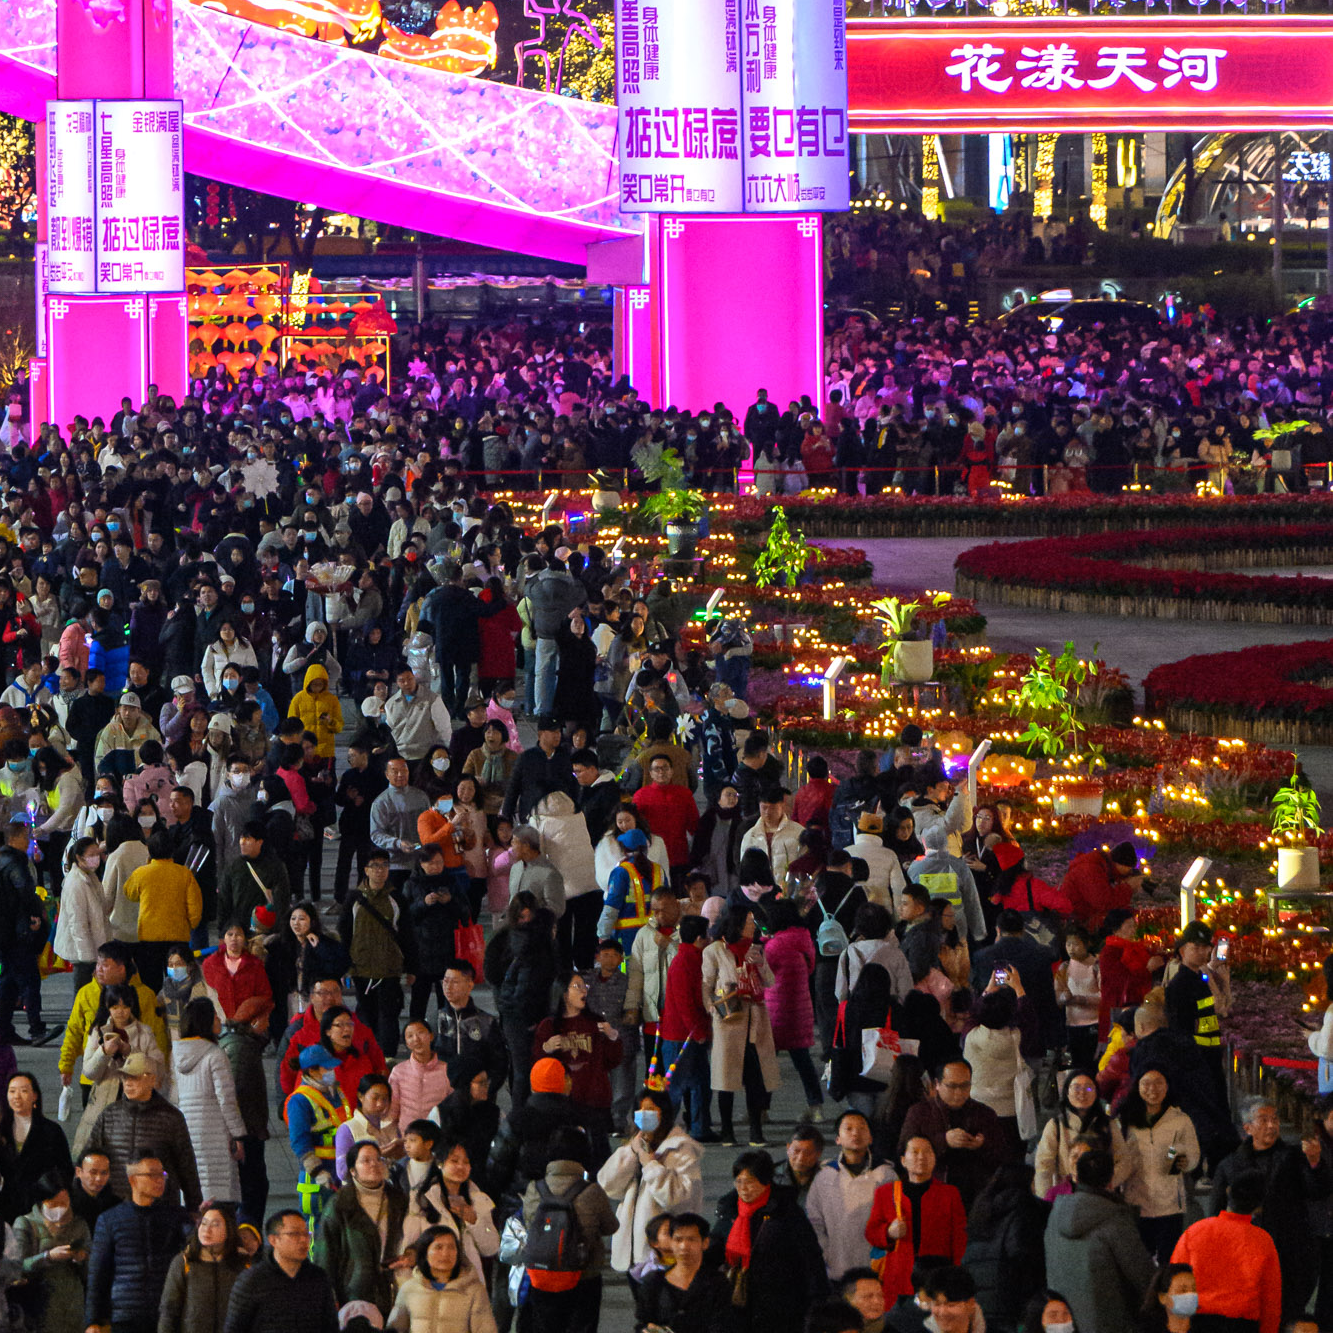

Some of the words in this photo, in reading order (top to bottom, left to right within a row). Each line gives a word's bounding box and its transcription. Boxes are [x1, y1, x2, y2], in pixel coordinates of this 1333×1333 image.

[642, 6, 660, 81] 身体健康
[763, 5, 778, 80] 身体健康
[945, 43, 1228, 92] 花漾天河
[132, 110, 180, 134] 金银满屋
[748, 105, 845, 158] 要乜有乜
[100, 111, 114, 209] 七星高照
[622, 173, 685, 204] 笑口常开
[746, 173, 800, 204] 六六大顺
[100, 261, 144, 282] 笑口常开
